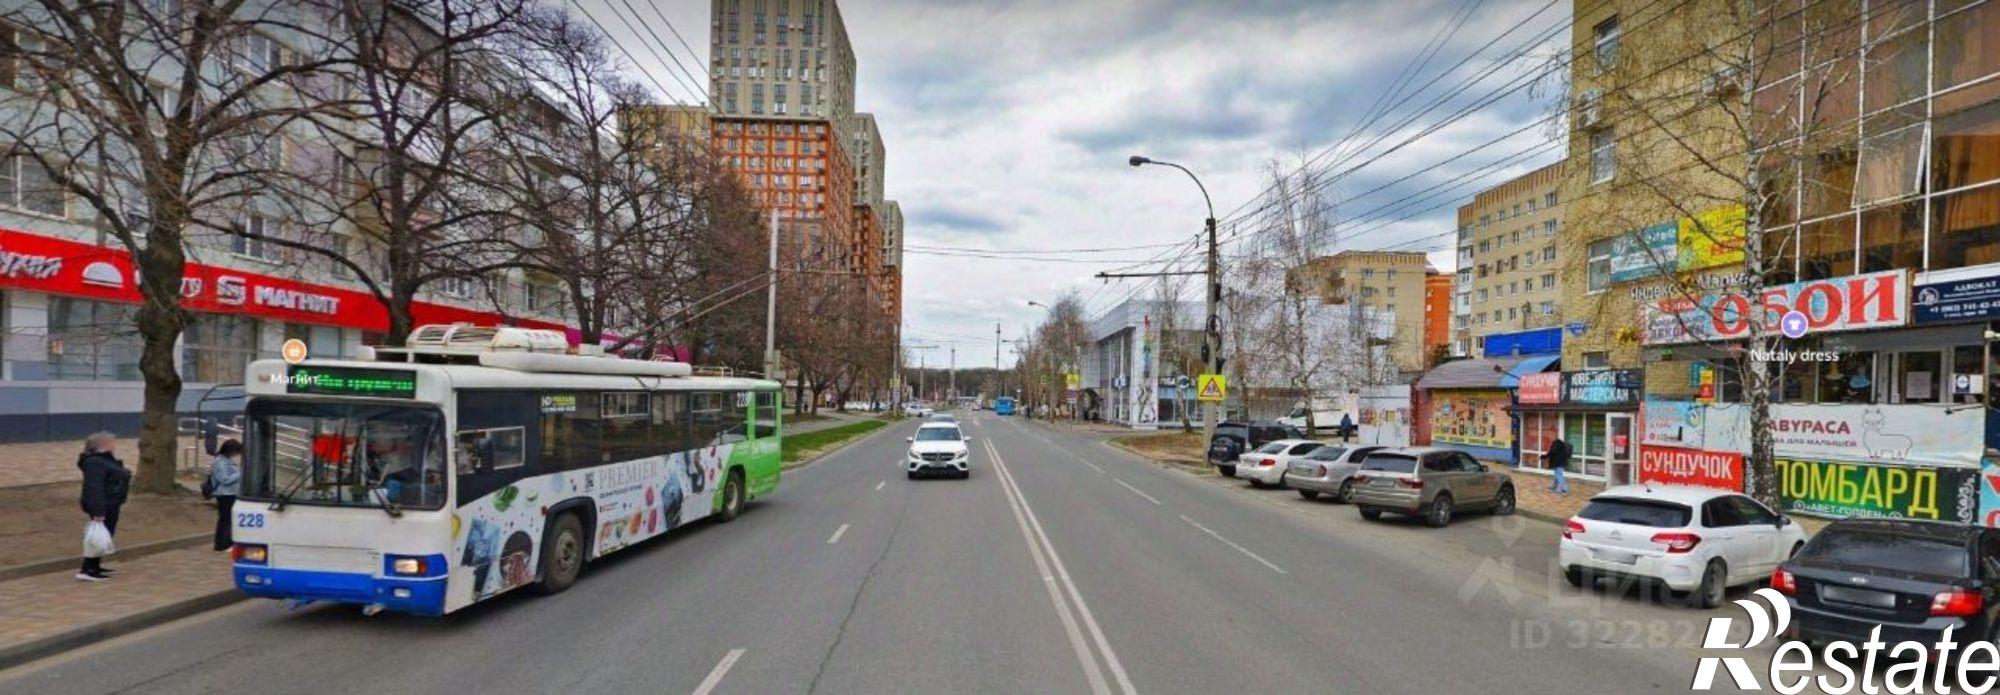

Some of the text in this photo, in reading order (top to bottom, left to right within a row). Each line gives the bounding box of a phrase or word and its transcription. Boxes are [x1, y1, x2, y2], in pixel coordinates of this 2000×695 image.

[254, 284, 341, 315] МАГНИТ
[1712, 275, 1899, 336] ОБОИ
[1642, 451, 1734, 480] СУНДУЧОК
[1774, 459, 1939, 520] ЛОМБАРД
[237, 513, 264, 529] 228
